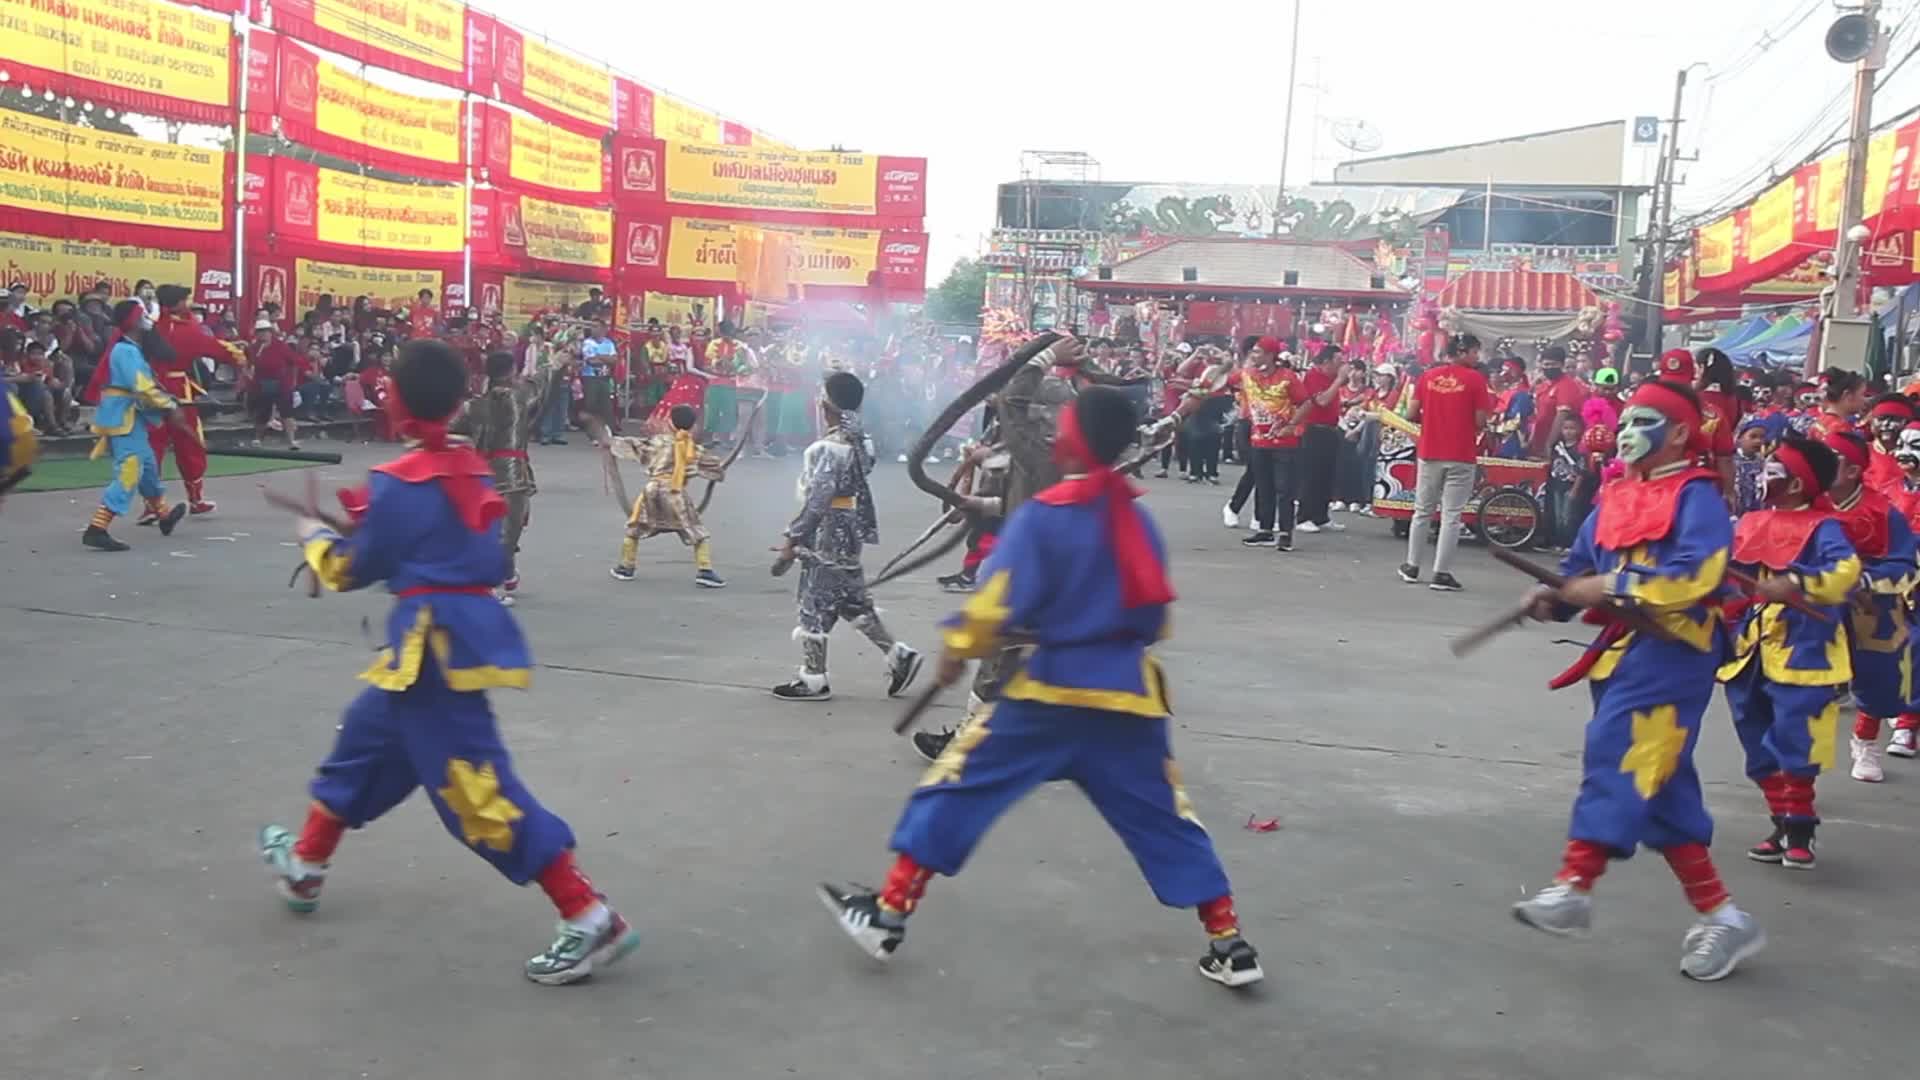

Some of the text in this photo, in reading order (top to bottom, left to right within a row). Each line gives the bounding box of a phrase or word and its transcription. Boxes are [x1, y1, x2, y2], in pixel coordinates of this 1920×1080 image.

[712, 160, 839, 186] เทศบาลเมืองชุมแสง
